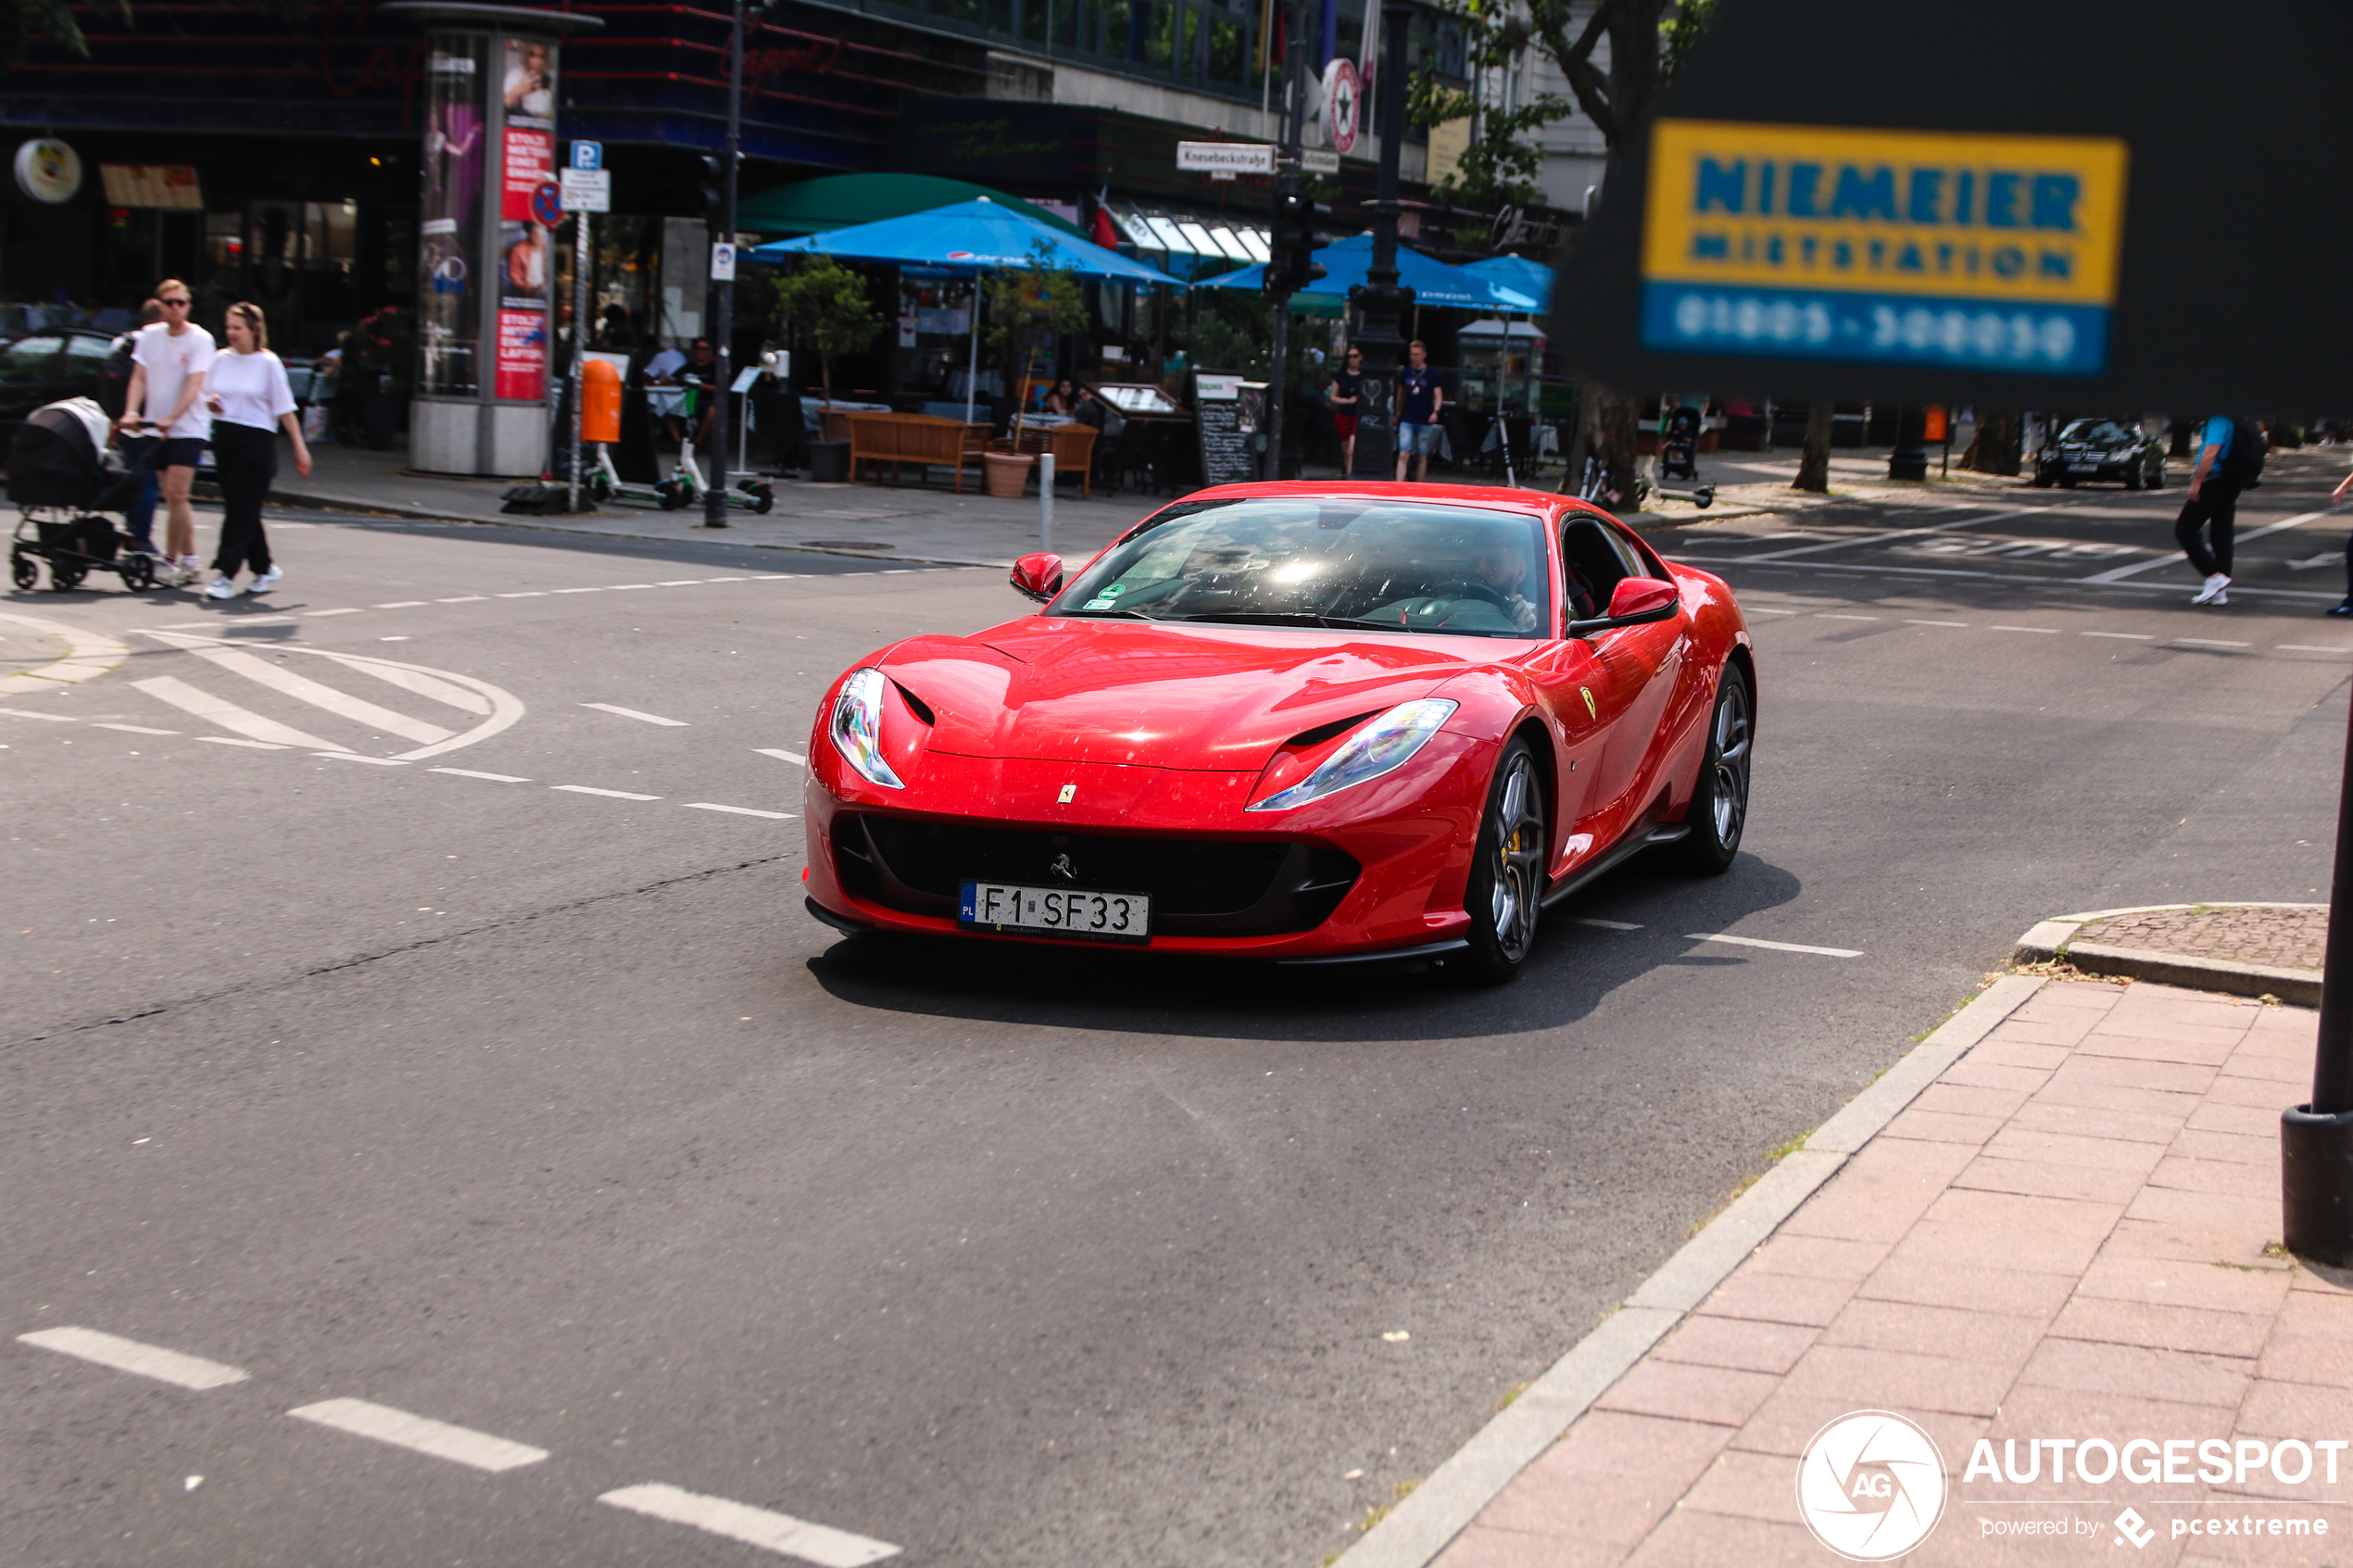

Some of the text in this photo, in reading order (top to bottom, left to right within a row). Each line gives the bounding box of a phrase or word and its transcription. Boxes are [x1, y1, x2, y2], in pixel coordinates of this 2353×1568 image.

[1185, 149, 1267, 168] Knesebeckstraße
[1694, 156, 2082, 232] NIEMEIER
[1692, 231, 2074, 282] MIETSTATION
[963, 906, 974, 915] PL
[985, 888, 1130, 930] F1 SF33
